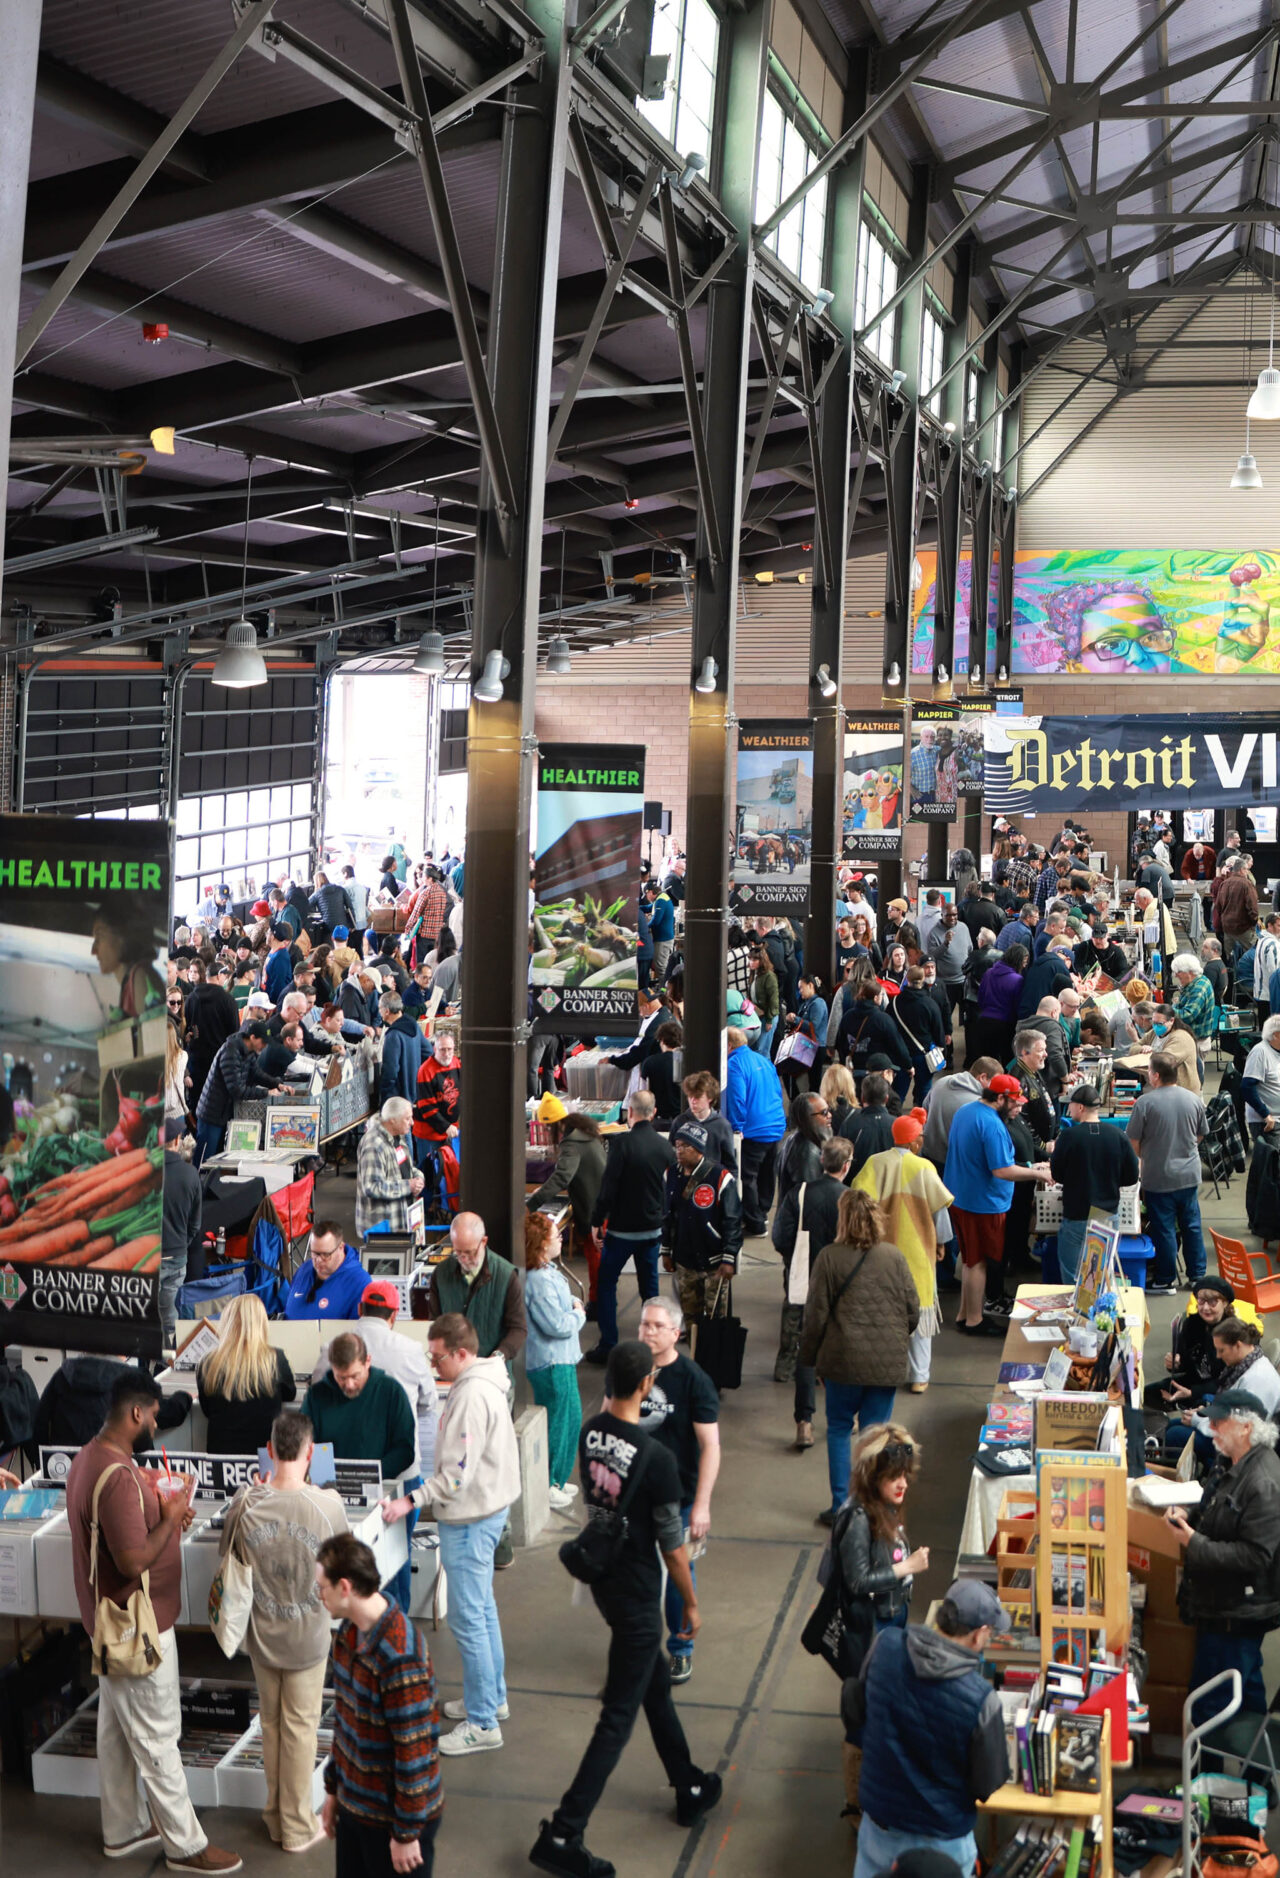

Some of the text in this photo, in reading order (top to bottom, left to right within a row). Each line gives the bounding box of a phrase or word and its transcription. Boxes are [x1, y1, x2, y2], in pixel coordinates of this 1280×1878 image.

[961, 703, 992, 711] HAPPIER
[917, 711, 954, 719] HAPPIER
[848, 722, 900, 732] WEALTHIER
[742, 736, 810, 747] WEALTHIER
[1005, 728, 1198, 792] Detroit
[542, 768, 641, 787] HEALTHIER
[858, 842, 898, 850] COMPANY
[0, 859, 162, 891] HEALTHIER
[756, 885, 807, 894] BANNER SIGN
[755, 892, 807, 902] COMPANY
[563, 989, 635, 1001] BANNER SIGN
[562, 1000, 634, 1014] COMPANY
[32, 1268, 153, 1297] BANNER SIGN
[32, 1288, 151, 1319] COMPANY
[1045, 1400, 1108, 1414] FREEDOM
[1041, 1454, 1073, 1464] FUNK
[1087, 1457, 1116, 1466] SOUL
